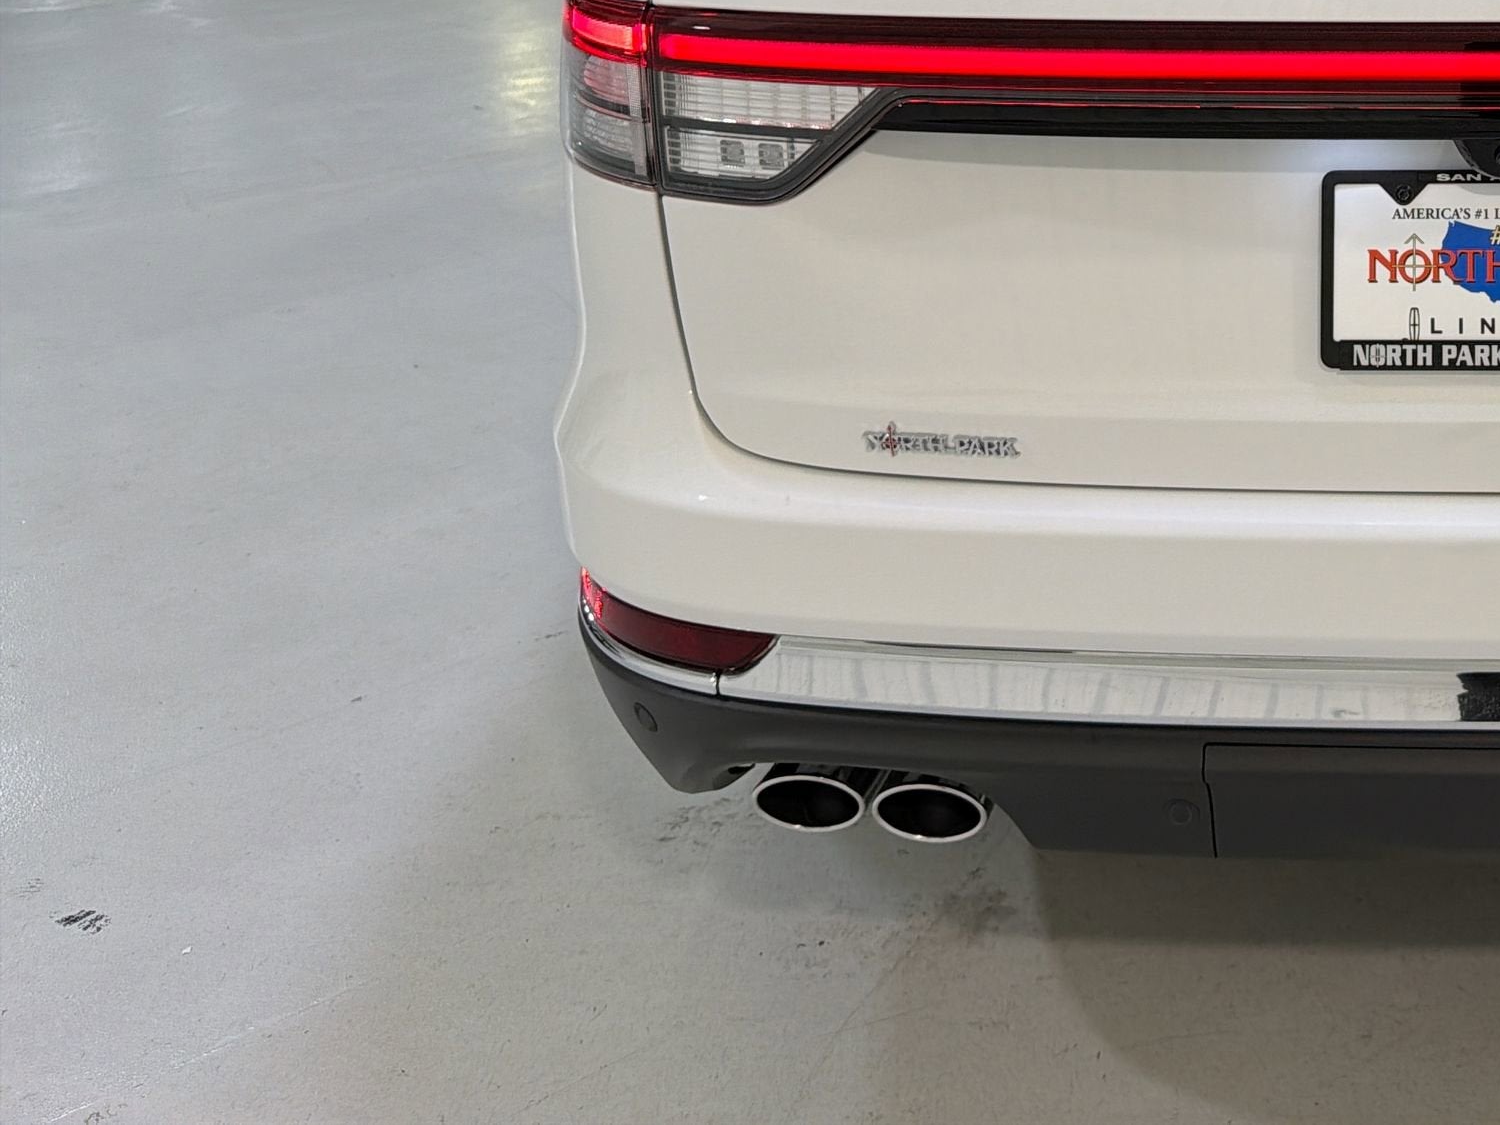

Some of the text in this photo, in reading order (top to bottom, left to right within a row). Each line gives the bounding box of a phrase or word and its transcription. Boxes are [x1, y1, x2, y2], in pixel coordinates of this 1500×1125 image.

[1436, 173, 1482, 182] SAN
[1392, 207, 1471, 220] AMERICA'S
[1474, 208, 1489, 220] #1
[1353, 344, 1433, 367] NORTH
[954, 434, 1021, 458] PARK
